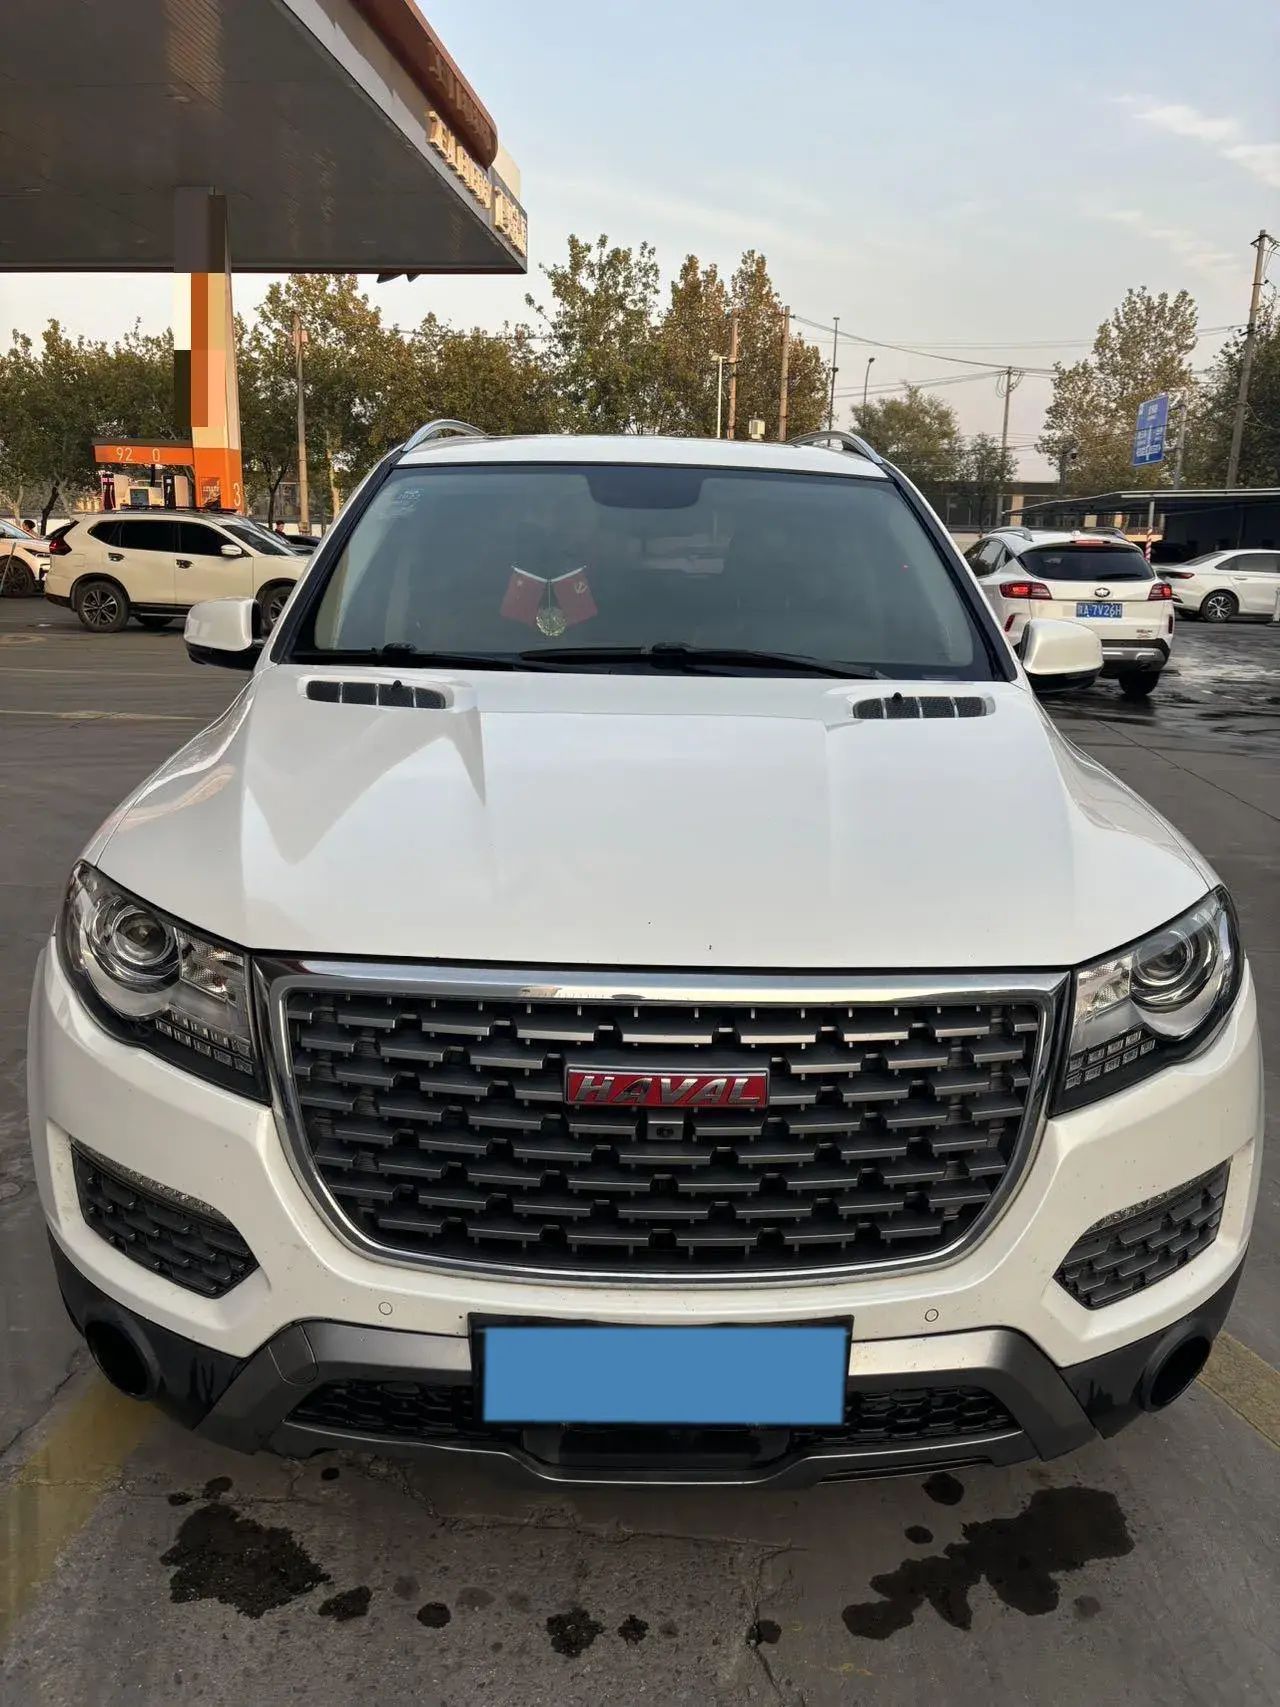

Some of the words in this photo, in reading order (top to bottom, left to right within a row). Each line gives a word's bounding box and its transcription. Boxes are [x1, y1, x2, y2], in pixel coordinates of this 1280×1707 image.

[116, 447, 133, 462] 92
[152, 448, 160, 462] 0
[233, 482, 241, 507] 3
[574, 1075, 761, 1104] HAVAL
